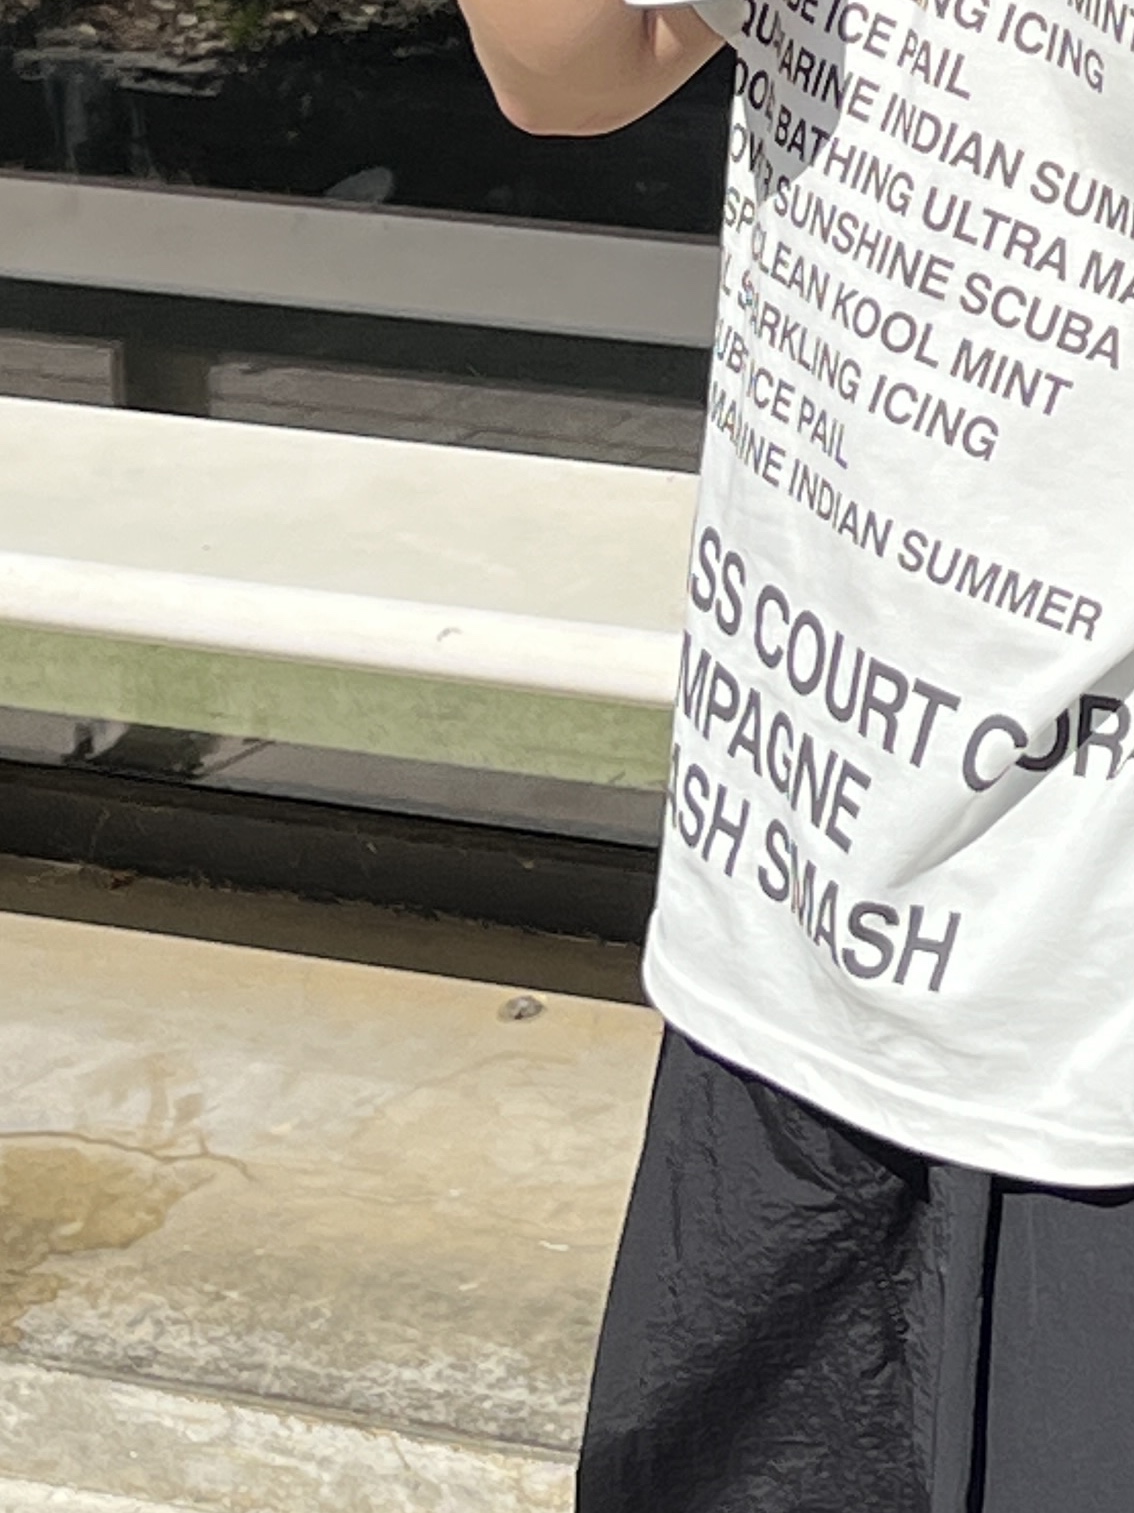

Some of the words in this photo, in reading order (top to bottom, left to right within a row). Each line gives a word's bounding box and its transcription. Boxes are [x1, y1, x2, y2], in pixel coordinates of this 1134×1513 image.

[896, 28, 971, 100] PAIL
[996, 3, 1104, 94] ICING
[774, 104, 915, 217] BATHING
[922, 186, 1067, 281] ULTRA
[880, 93, 1025, 189] INDIAN
[773, 175, 955, 300] SUNSHINE
[959, 272, 1120, 370] SCUBA
[831, 282, 939, 370] KOOL
[949, 337, 1074, 416] MINT
[746, 358, 796, 425] ICE
[797, 394, 848, 470] PAIL
[868, 374, 999, 462] ICING
[788, 458, 893, 557] INDIAN
[898, 528, 1103, 641] SUMMER
[754, 584, 961, 768] COURT
